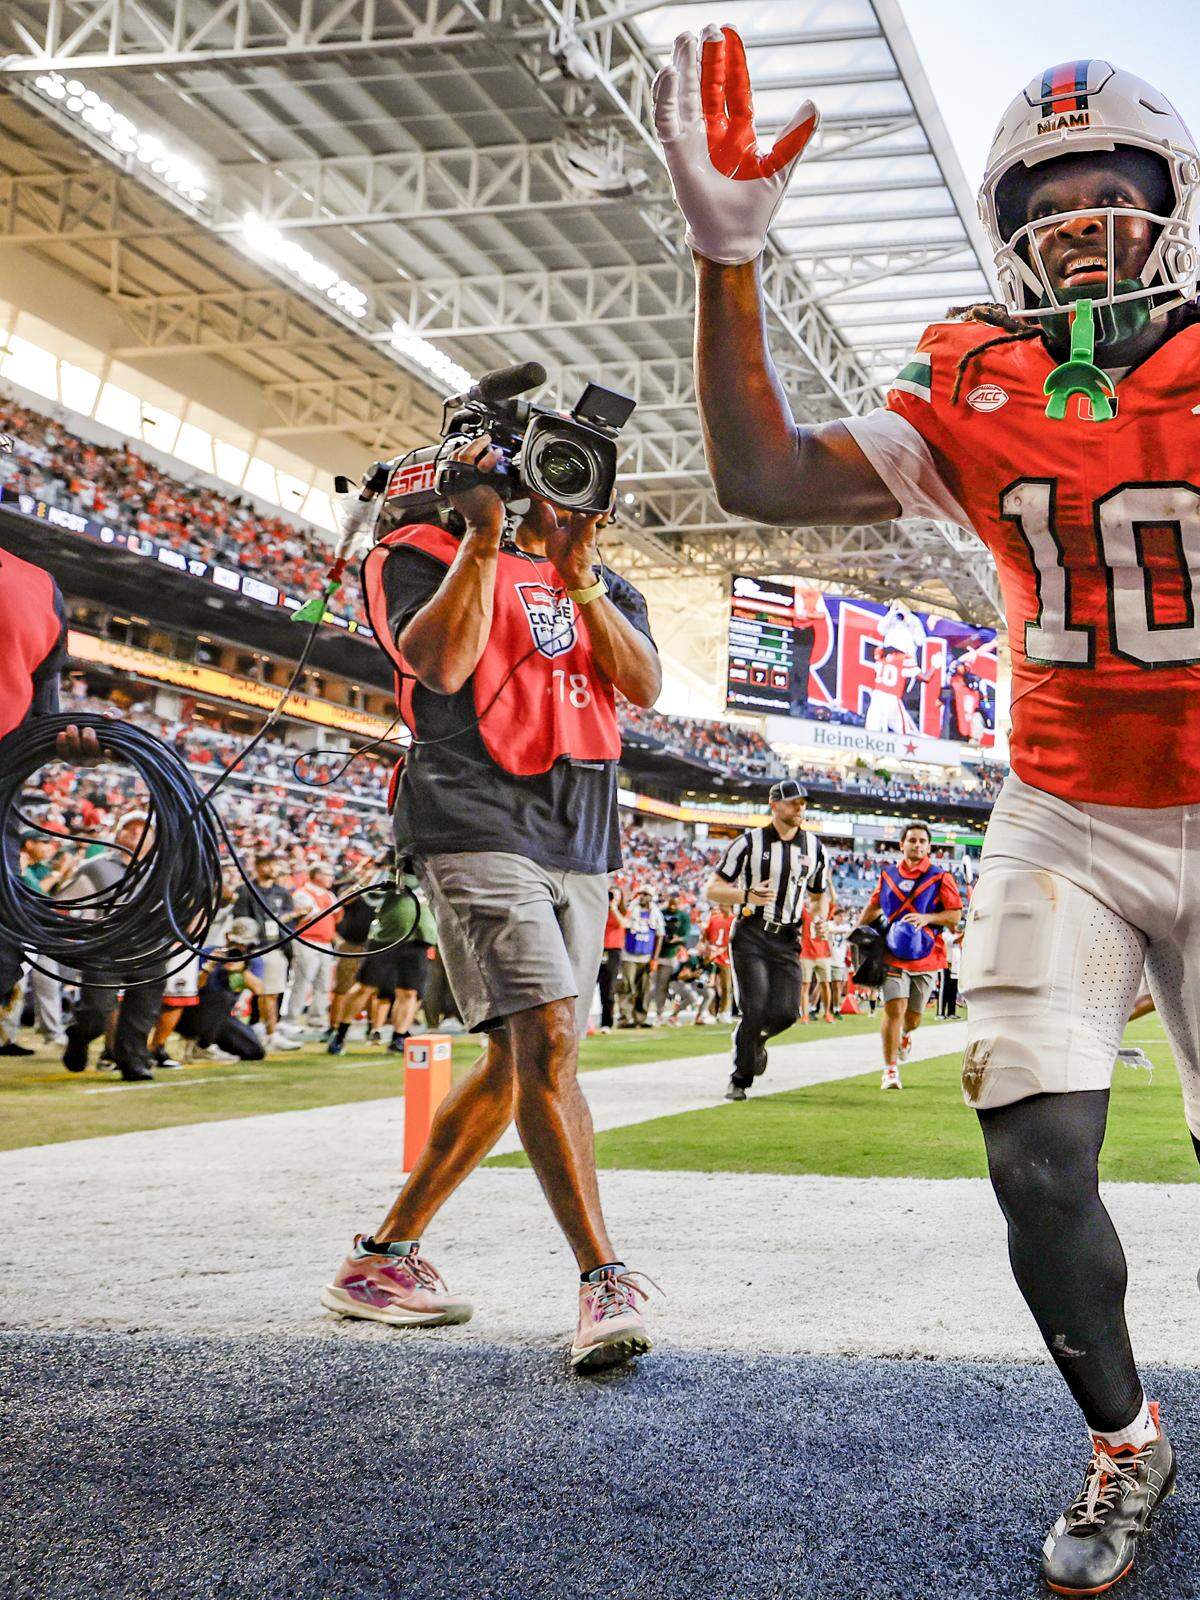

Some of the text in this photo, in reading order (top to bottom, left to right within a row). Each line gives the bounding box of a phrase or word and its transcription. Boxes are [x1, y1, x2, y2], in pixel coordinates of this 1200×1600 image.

[1037, 112, 1090, 135] MIAMI
[973, 392, 1002, 401] ACC
[813, 727, 896, 754] Heineken
